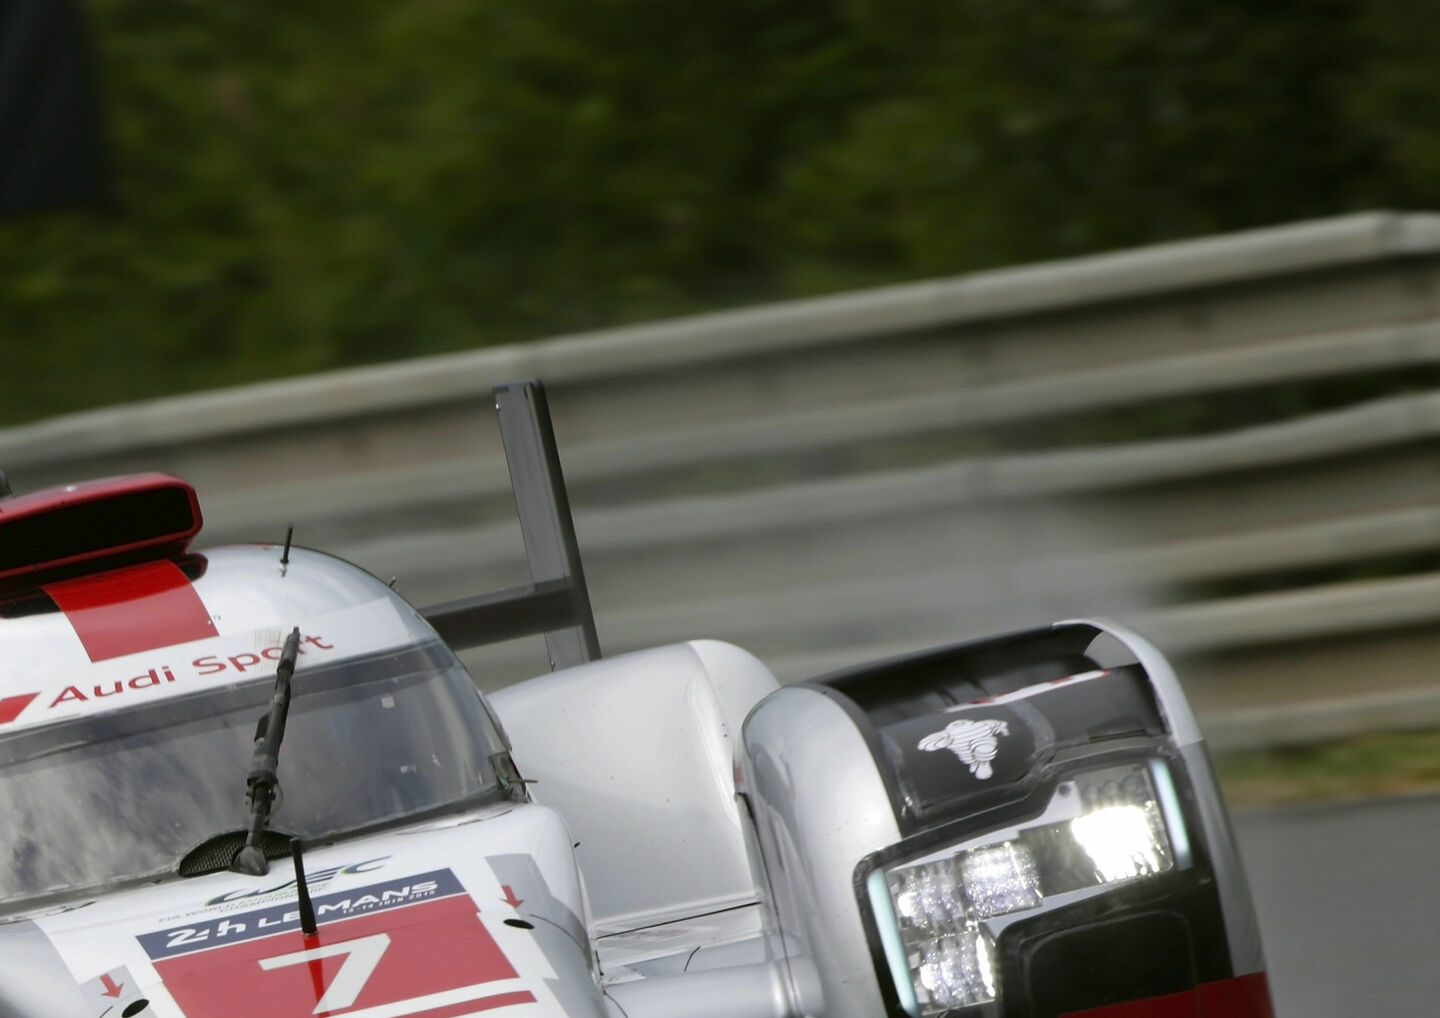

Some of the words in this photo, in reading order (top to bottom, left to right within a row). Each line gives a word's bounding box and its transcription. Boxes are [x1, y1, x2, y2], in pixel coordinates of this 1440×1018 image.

[48, 664, 176, 709] Audi
[258, 912, 301, 928] LE
[317, 880, 438, 915] MANS
[258, 932, 392, 1015] 7
